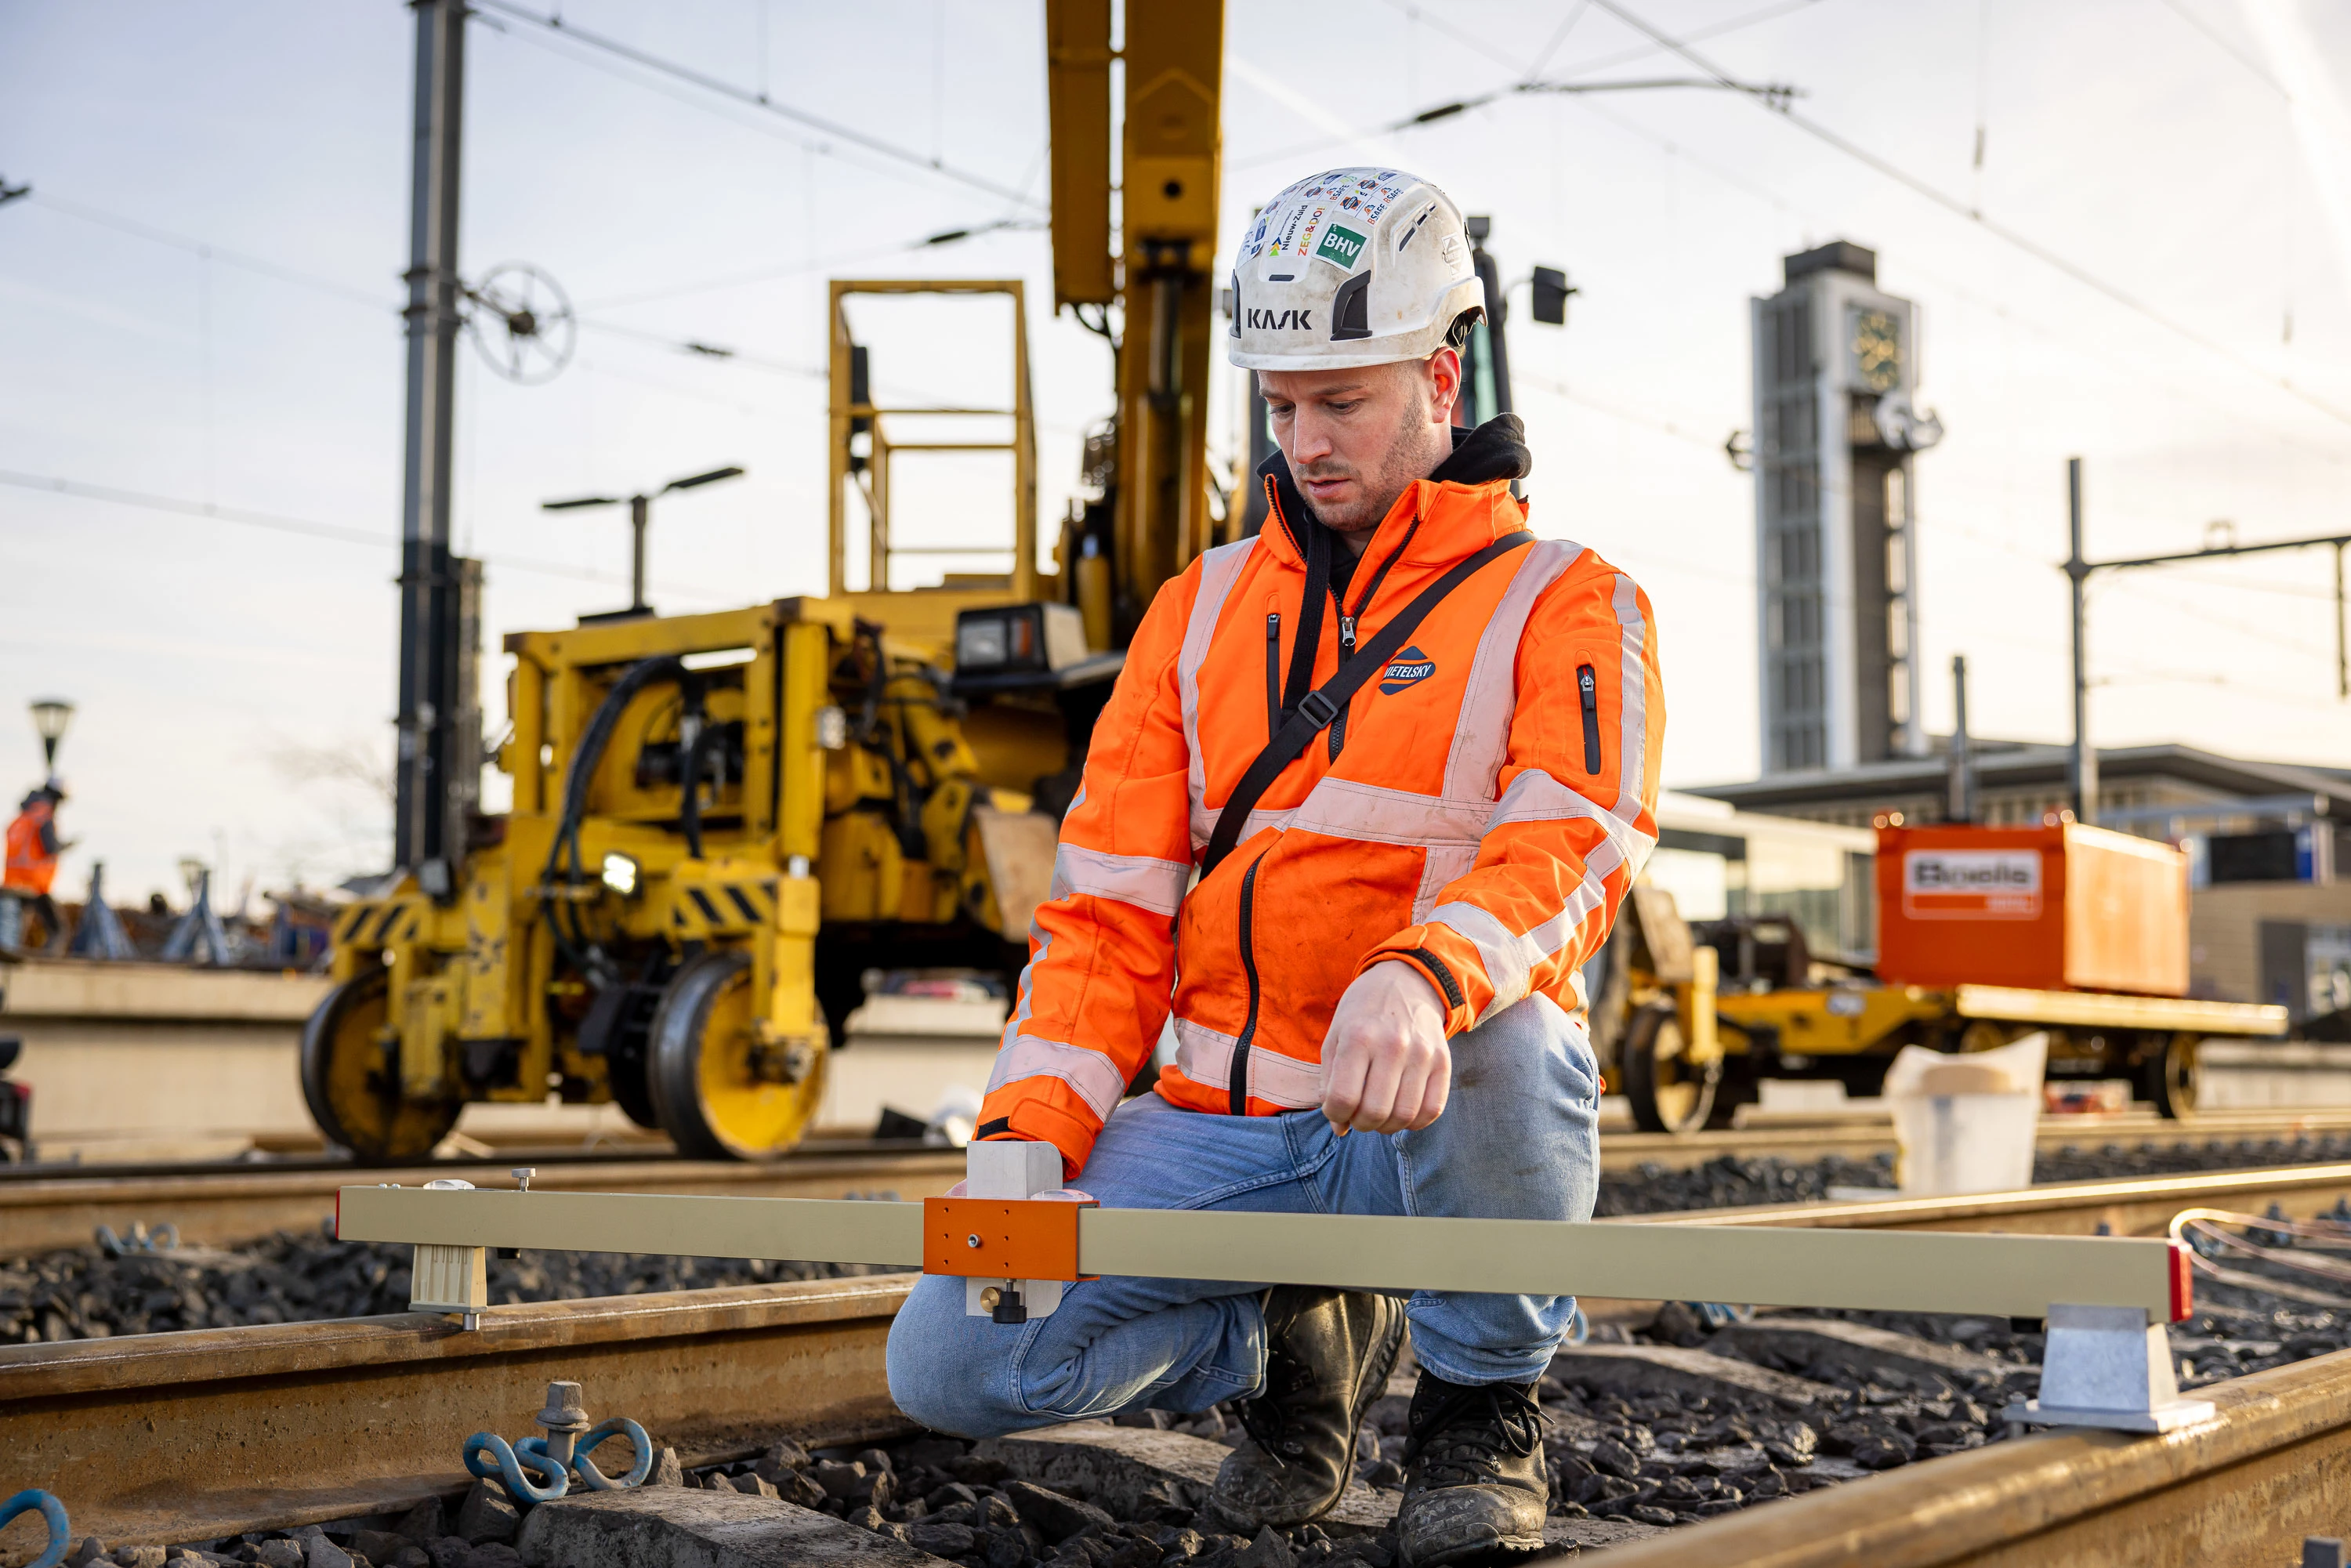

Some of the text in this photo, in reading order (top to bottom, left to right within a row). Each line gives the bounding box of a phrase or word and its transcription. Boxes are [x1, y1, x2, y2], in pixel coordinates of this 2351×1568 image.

[1281, 205, 1309, 251] Nieuw-Zuid
[1323, 232, 1361, 257] BHV
[1248, 308, 1312, 330] KASK
[1384, 664, 1432, 678] IETELSKY
